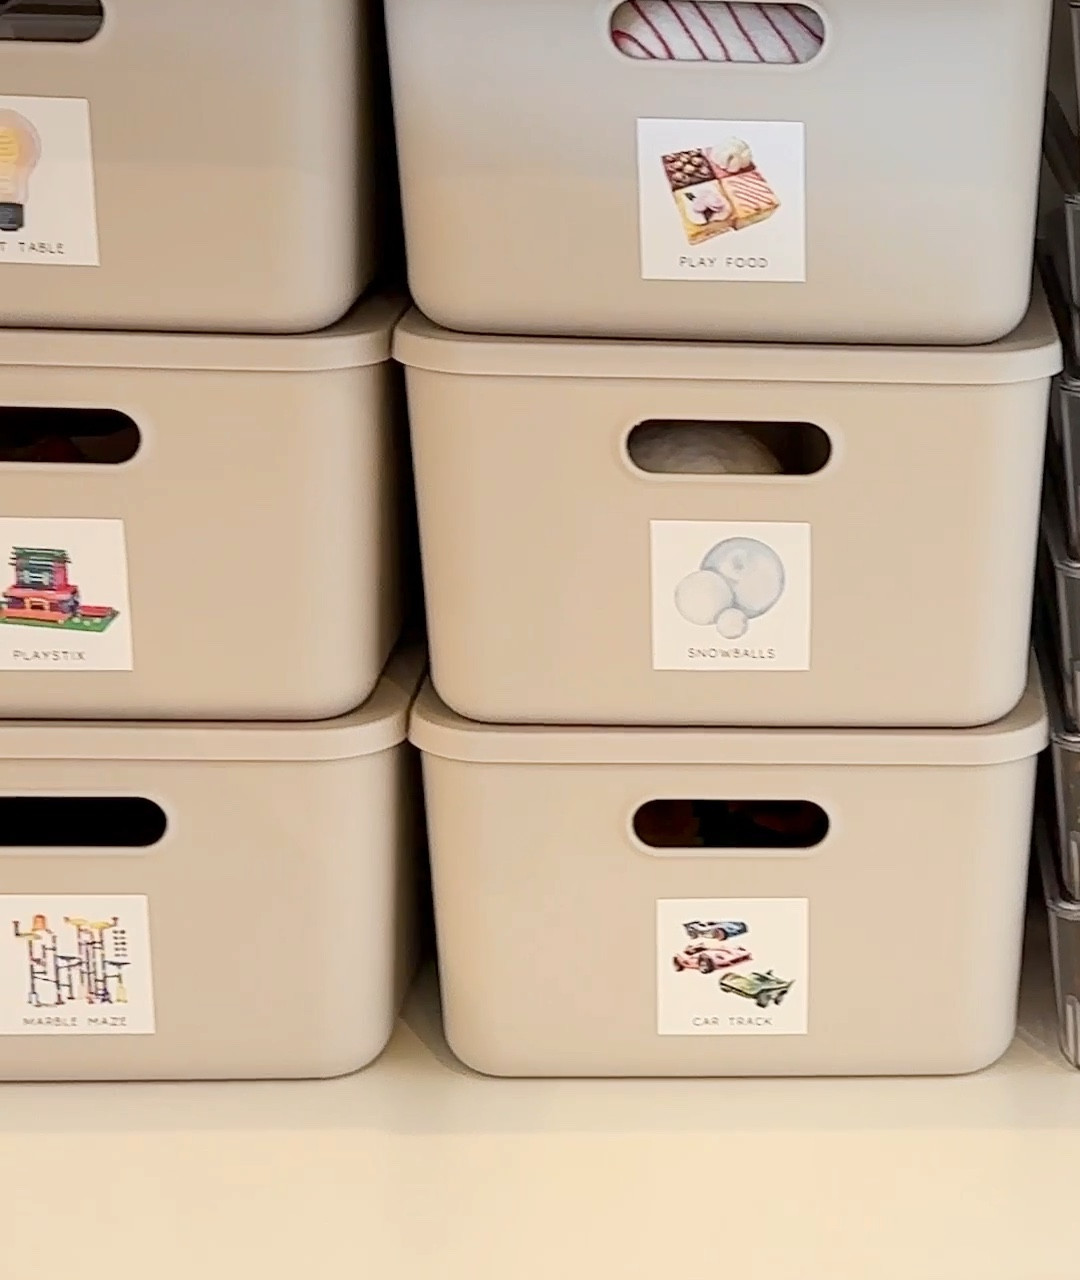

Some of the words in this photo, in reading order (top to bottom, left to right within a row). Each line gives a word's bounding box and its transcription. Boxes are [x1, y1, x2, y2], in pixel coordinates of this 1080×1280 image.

[17, 241, 65, 255] TABLE
[679, 256, 717, 269] PLAY
[725, 256, 769, 269] FOOD
[12, 649, 86, 662] PLAYSTIX
[687, 647, 775, 659] SNOWBALLS
[22, 1016, 78, 1027] MARBLE
[87, 1016, 127, 1027] MAZE
[691, 1016, 720, 1027] CAR
[728, 1016, 773, 1027] TRACK
